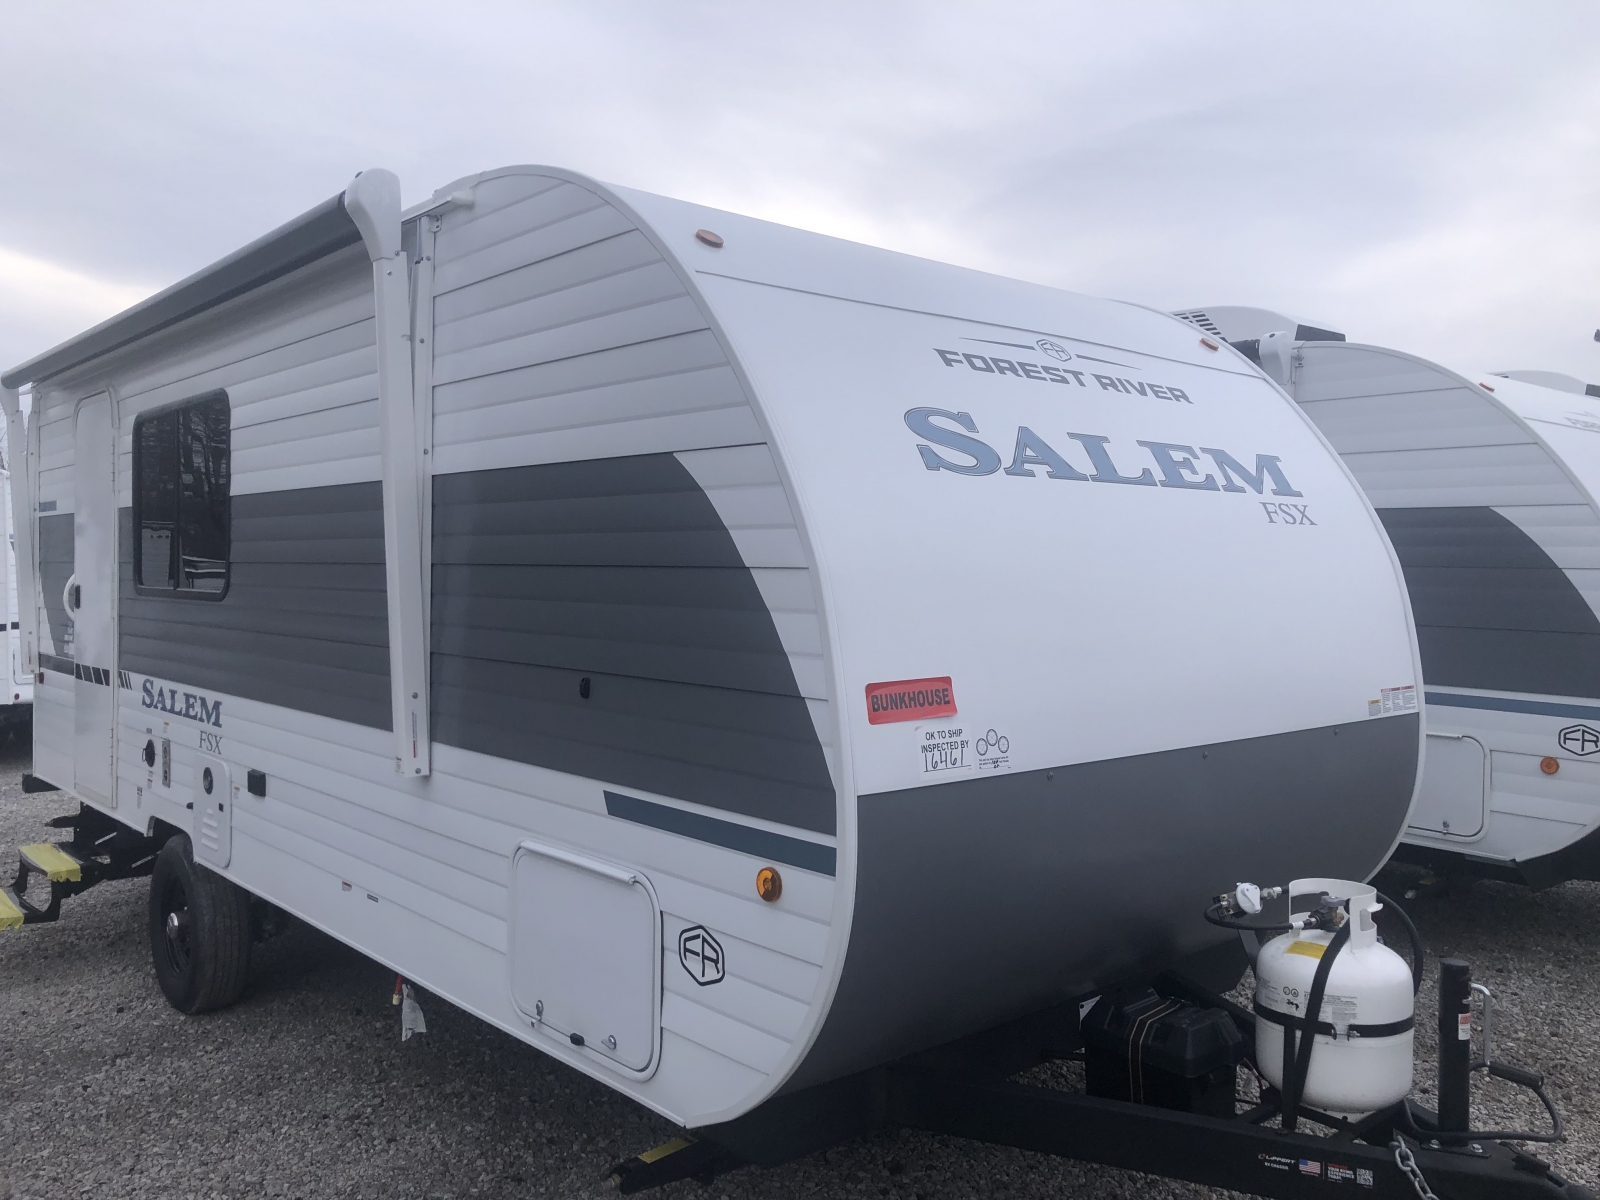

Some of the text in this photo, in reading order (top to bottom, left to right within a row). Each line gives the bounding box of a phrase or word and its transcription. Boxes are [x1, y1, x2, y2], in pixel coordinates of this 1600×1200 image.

[932, 348, 1194, 405] FOREST RIVER
[904, 406, 1304, 498] SALEM
[1259, 501, 1318, 526] FSX
[142, 678, 222, 728] SALEM
[871, 688, 951, 712] BUNKHOUSE
[199, 730, 222, 755] FSX
[921, 740, 970, 754] INSPECTED BY
[925, 728, 963, 741] OK TO SHIP
